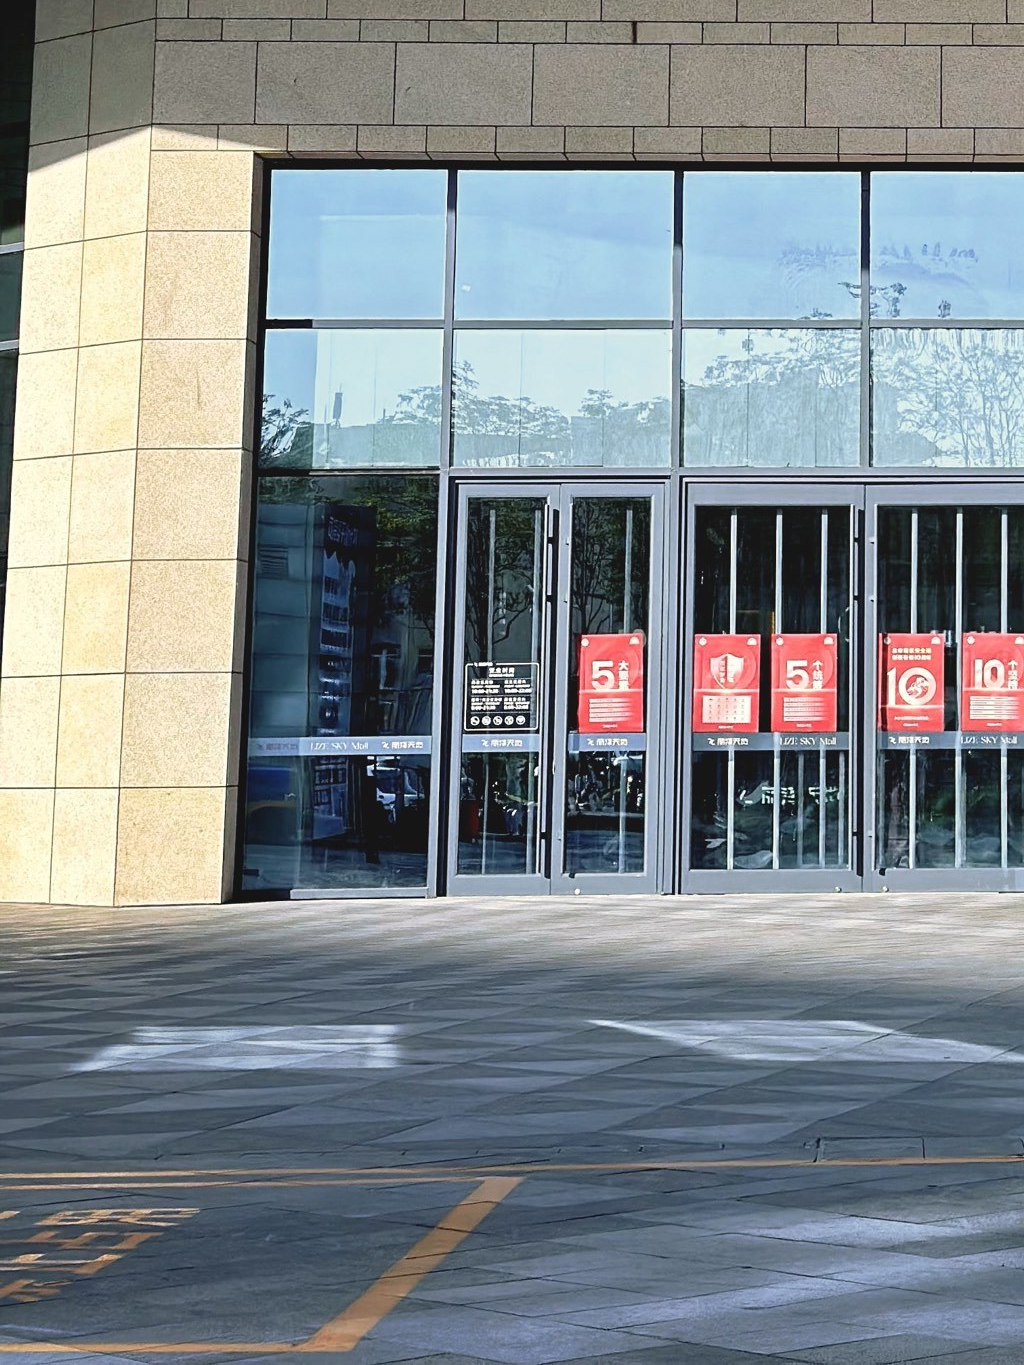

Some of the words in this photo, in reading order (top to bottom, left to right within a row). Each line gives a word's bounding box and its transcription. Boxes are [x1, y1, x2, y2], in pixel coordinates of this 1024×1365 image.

[591, 660, 615, 689] 5
[786, 660, 810, 689] 5
[974, 658, 1005, 689] 10
